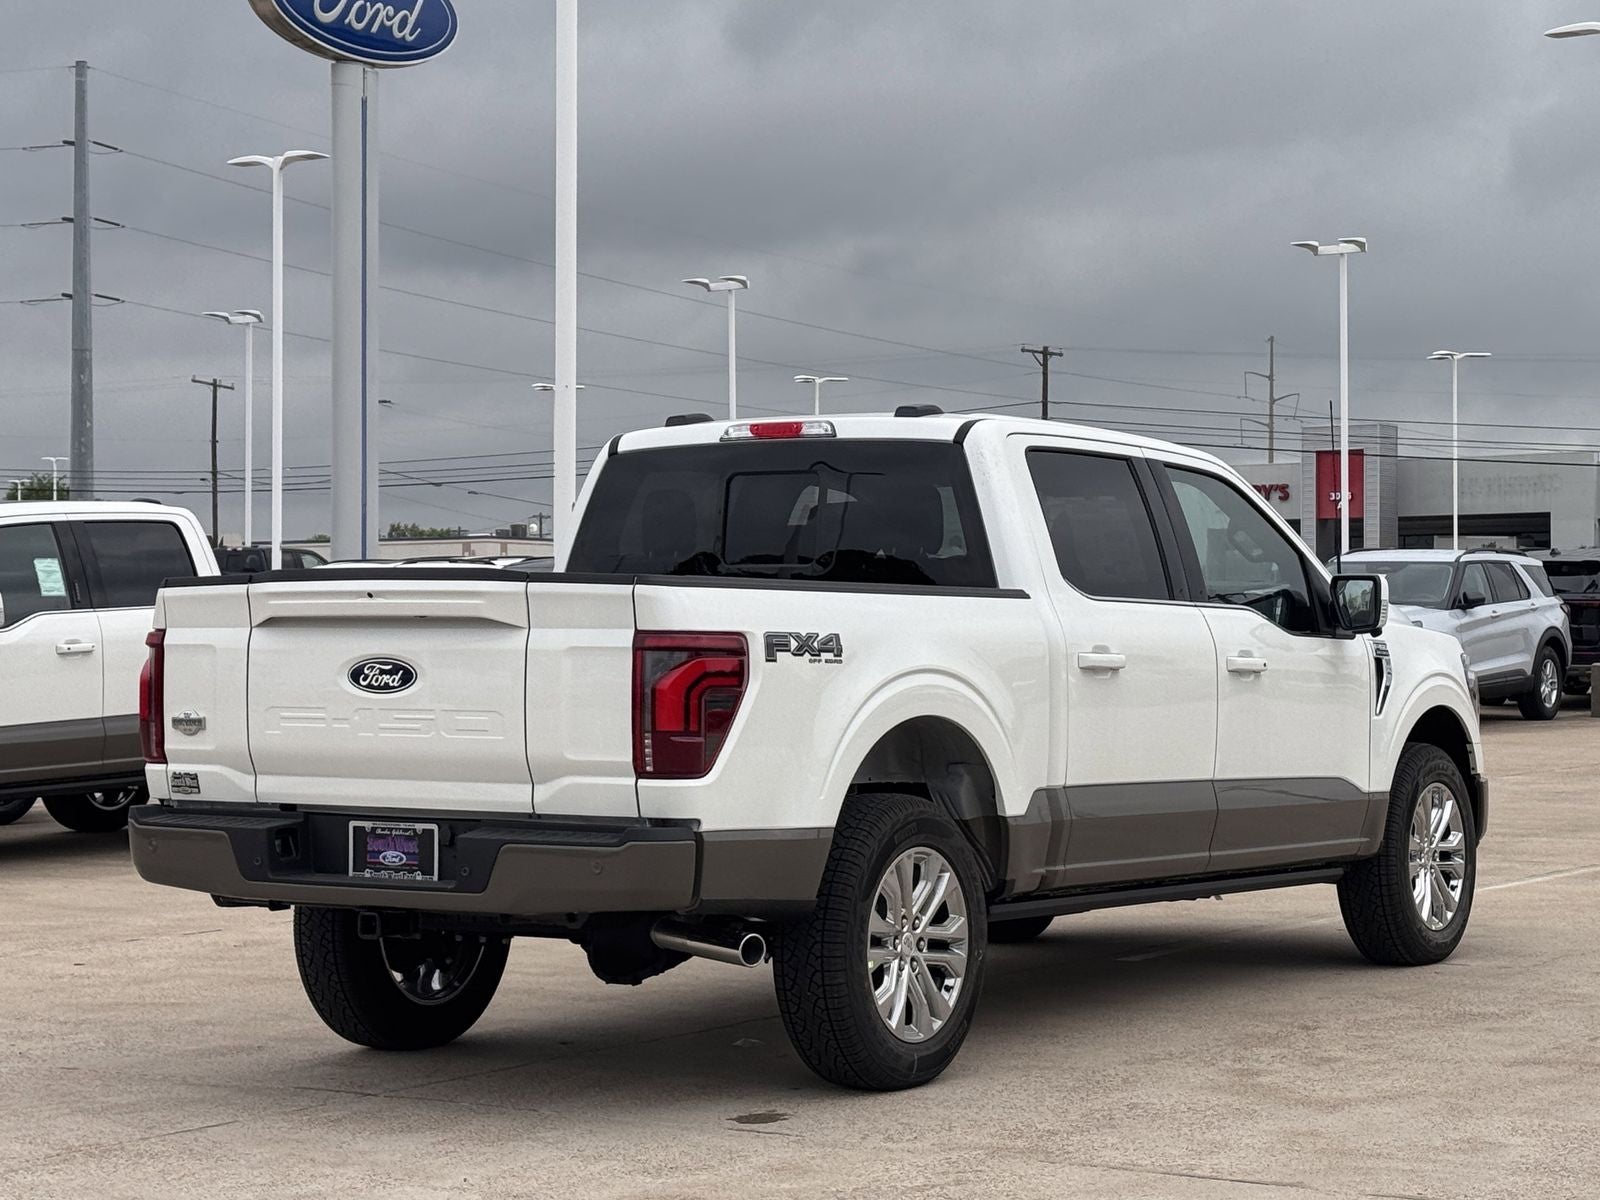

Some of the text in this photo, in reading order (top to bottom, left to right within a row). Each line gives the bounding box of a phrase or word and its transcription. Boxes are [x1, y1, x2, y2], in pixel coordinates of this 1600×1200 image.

[763, 631, 843, 662] FX4
[359, 663, 403, 688] Ford
[264, 706, 505, 739] F-150
